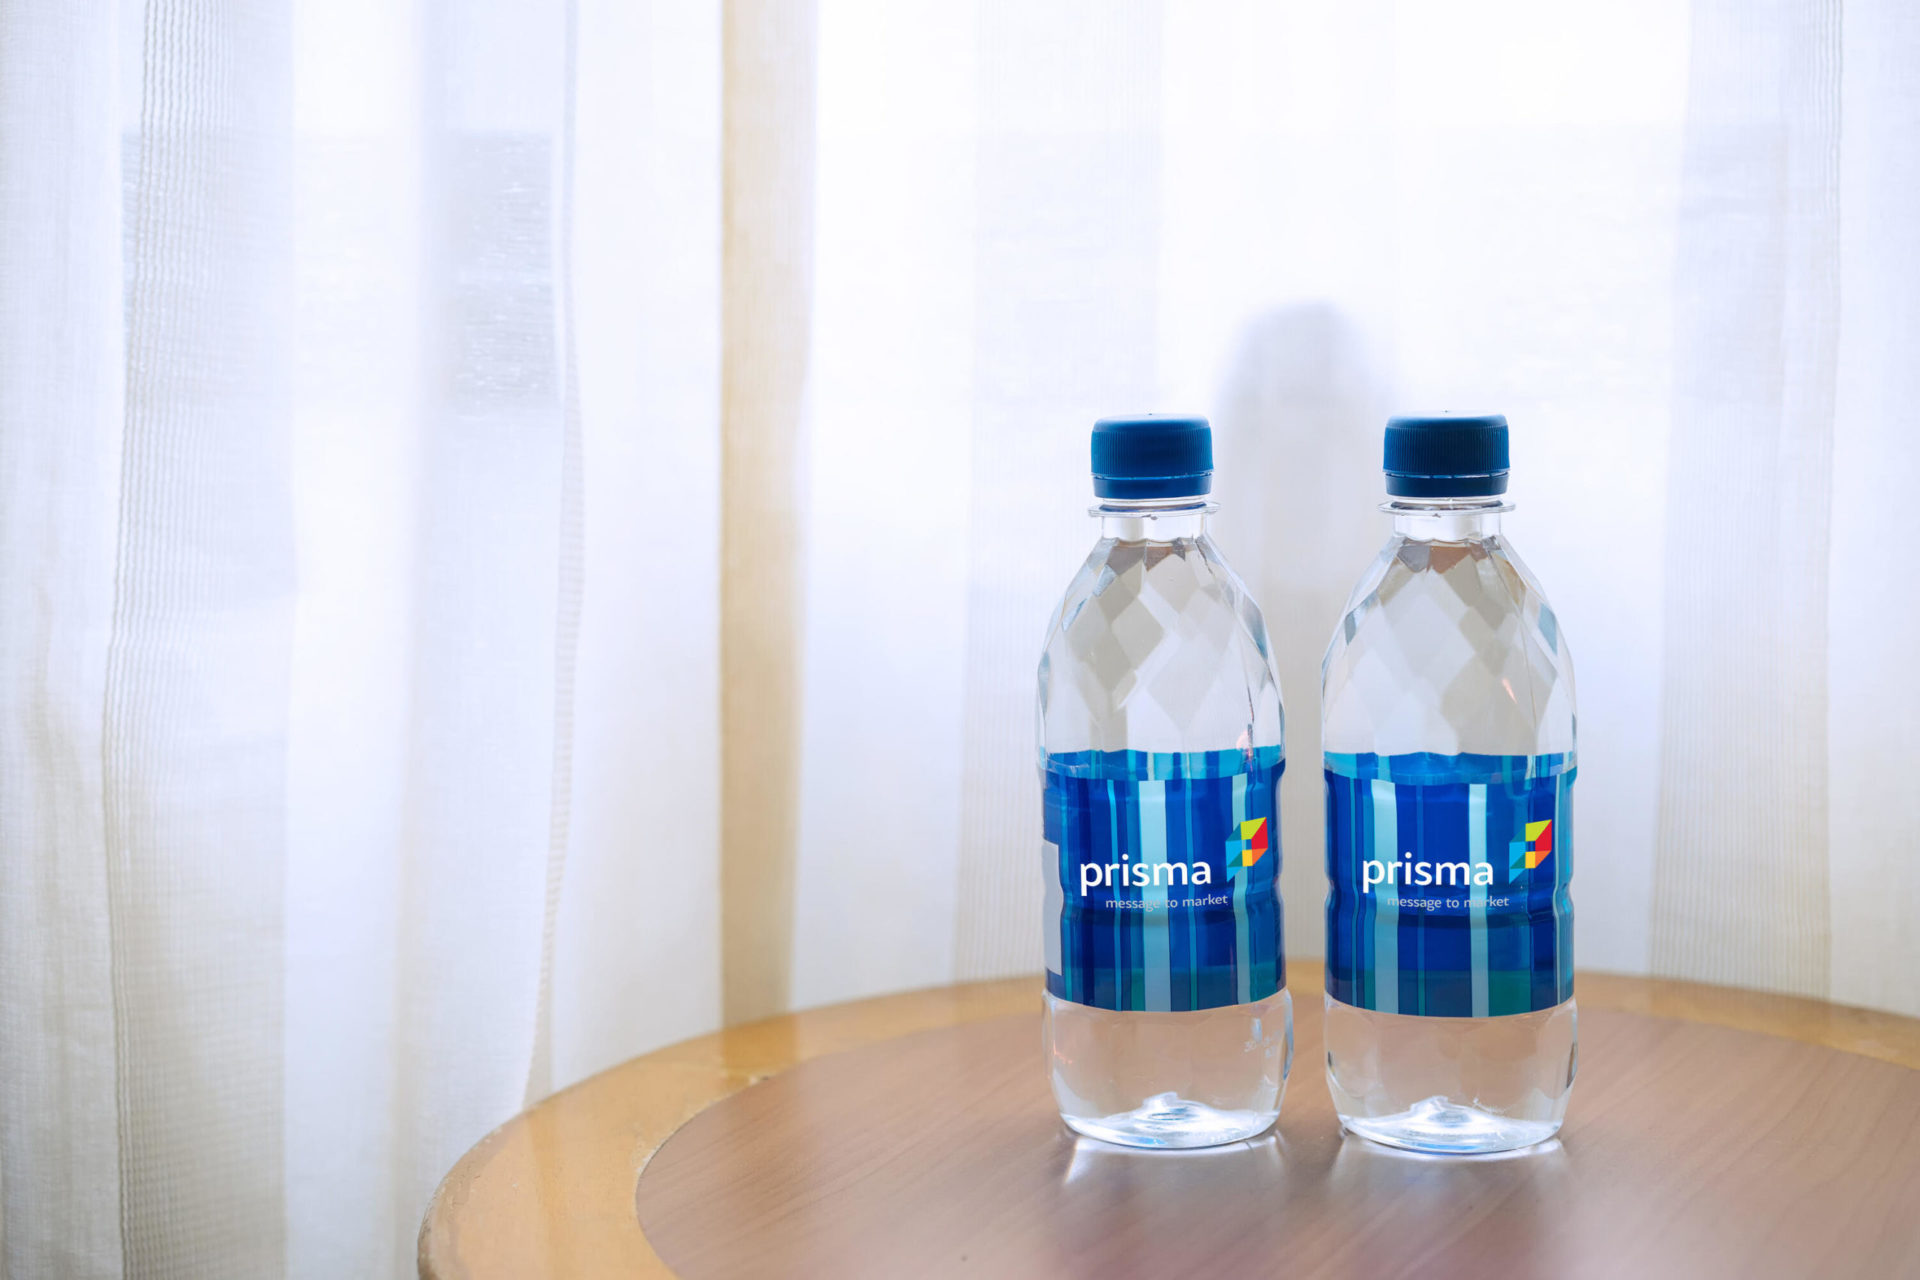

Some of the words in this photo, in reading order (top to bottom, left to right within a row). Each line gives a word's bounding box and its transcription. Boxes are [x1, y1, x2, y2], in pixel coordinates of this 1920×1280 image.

[1080, 854, 1212, 896] prisma
[1363, 852, 1493, 893] prisma
[1105, 898, 1160, 912] message
[1165, 898, 1178, 909] to
[1182, 894, 1228, 907] market
[1387, 897, 1442, 911] message
[1446, 897, 1459, 908] to
[1463, 896, 1509, 908] market
